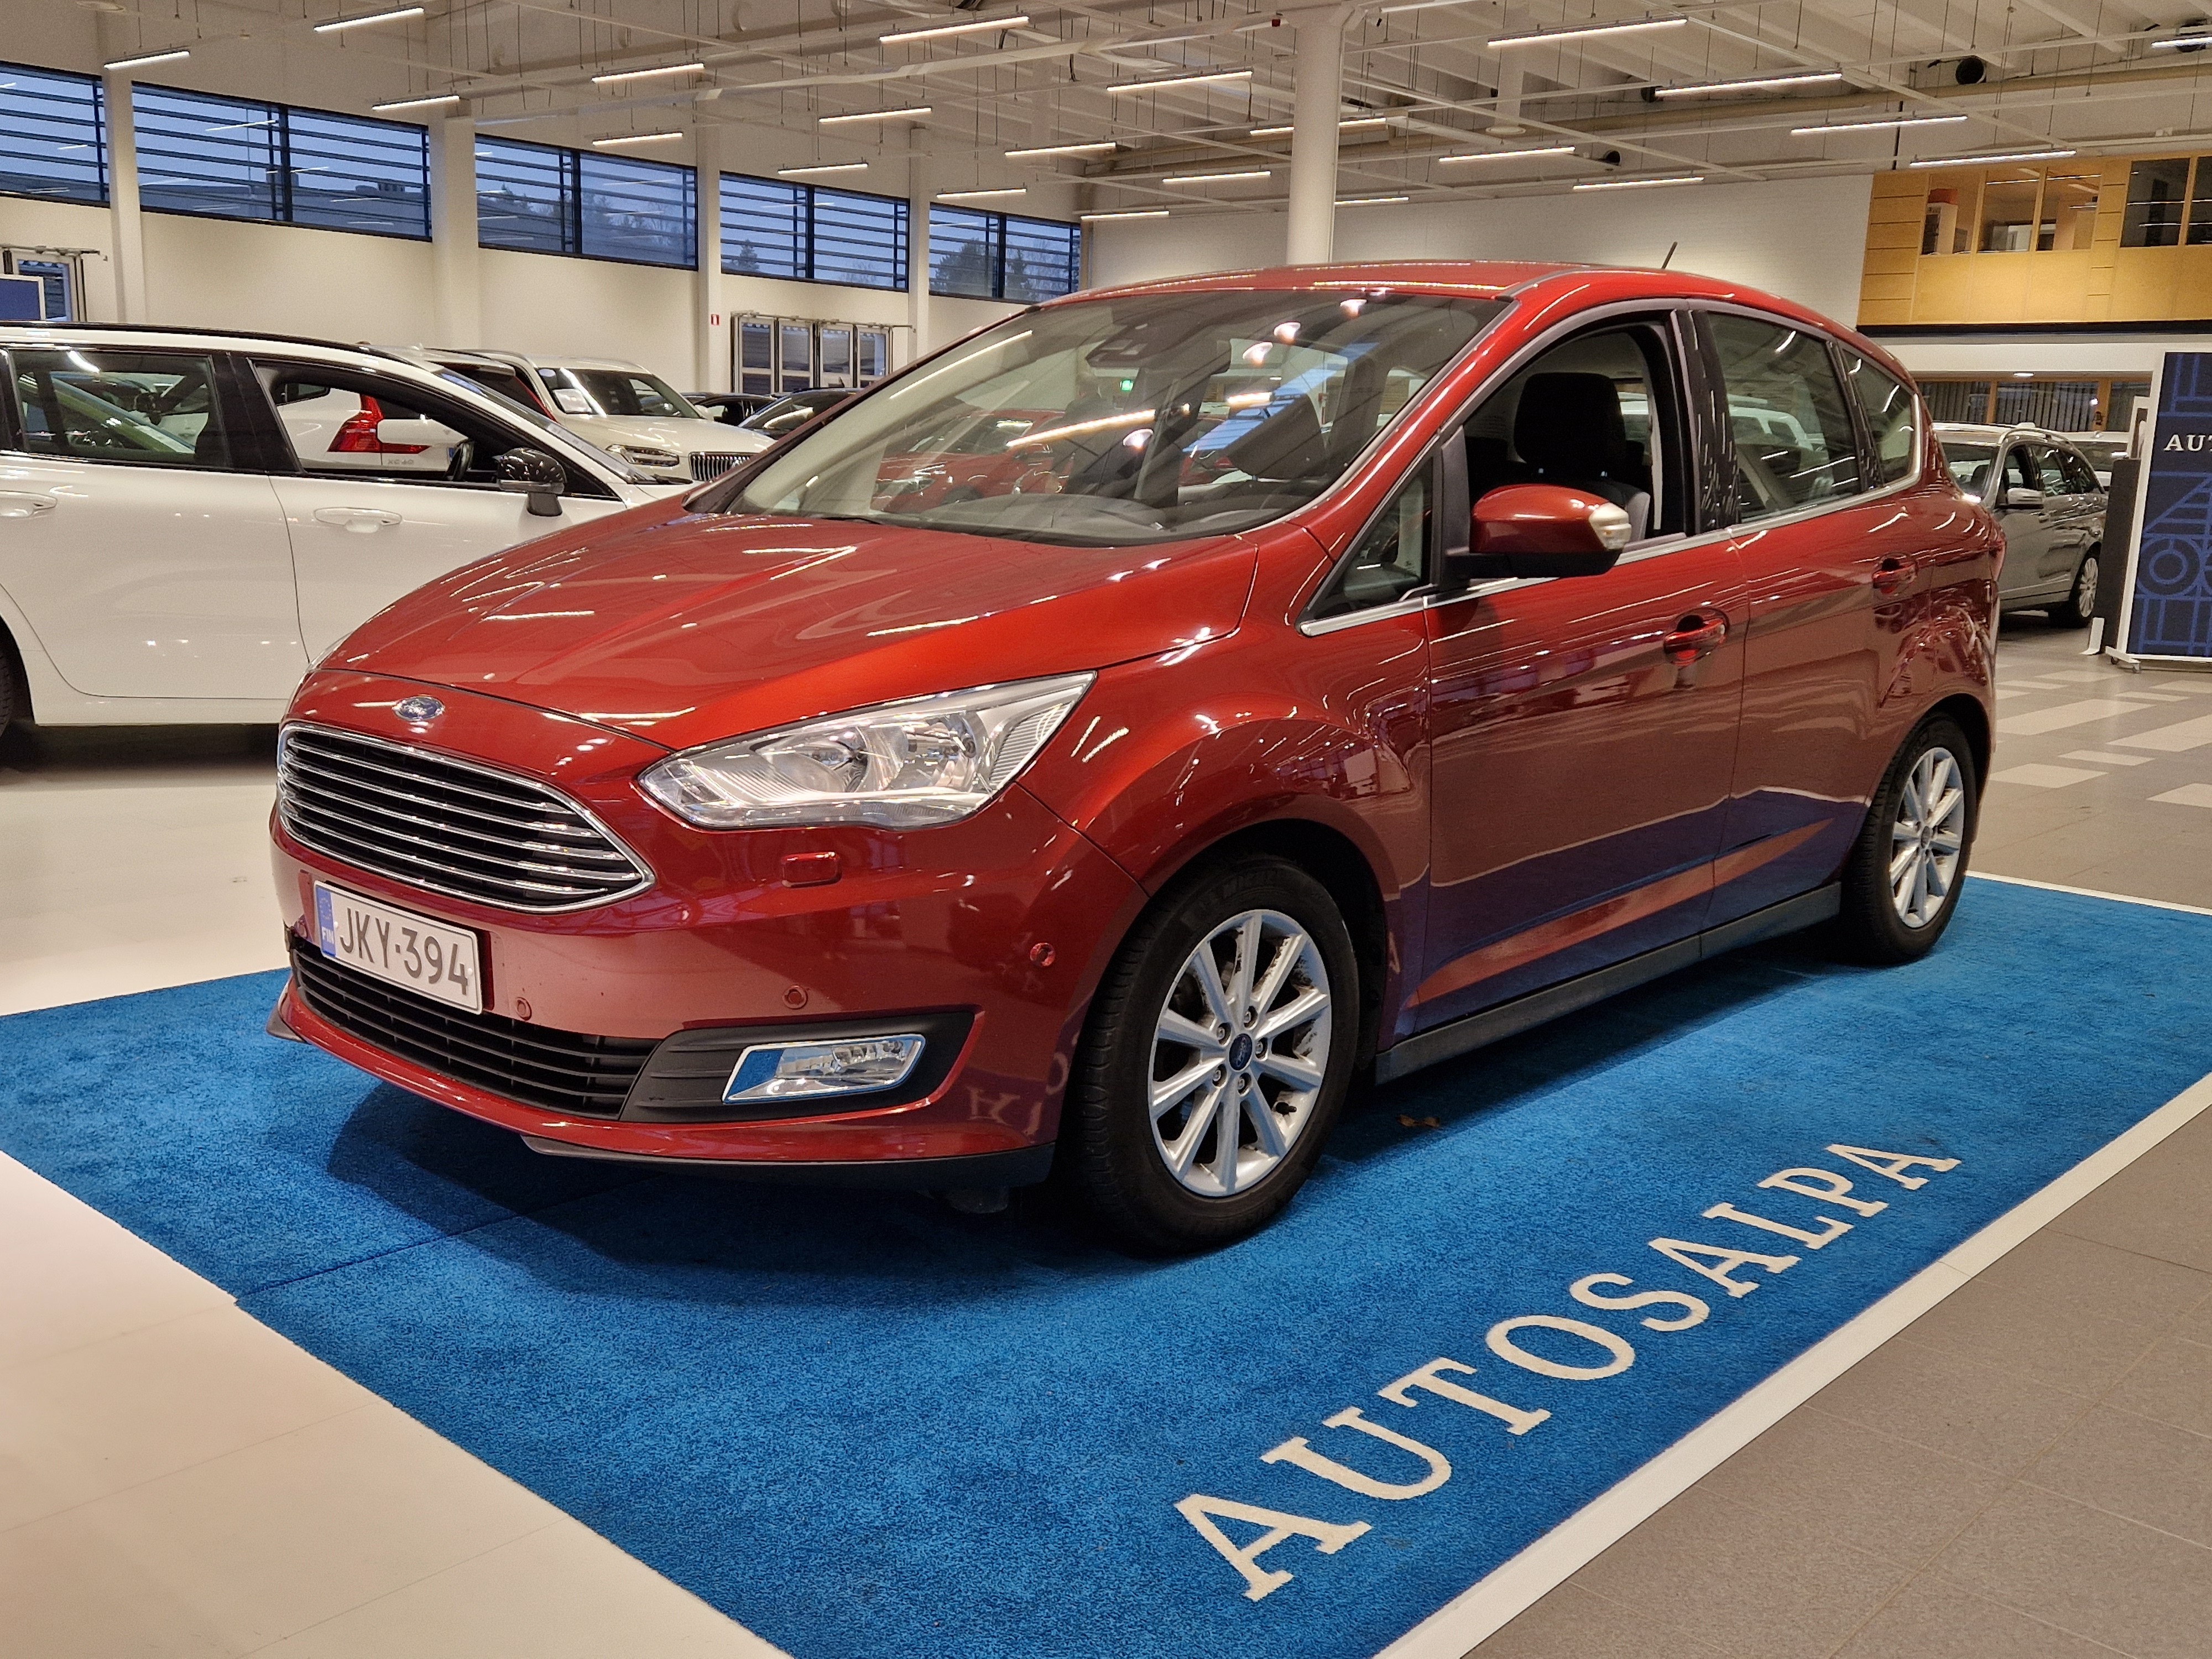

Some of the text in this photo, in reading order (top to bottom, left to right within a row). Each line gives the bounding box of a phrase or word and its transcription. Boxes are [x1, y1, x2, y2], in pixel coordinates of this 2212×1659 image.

[2163, 434, 2212, 451] AU
[321, 926, 335, 945] FIN
[339, 907, 468, 995] JKY-394
[1173, 1142, 1963, 1601] AUTOSALPA
